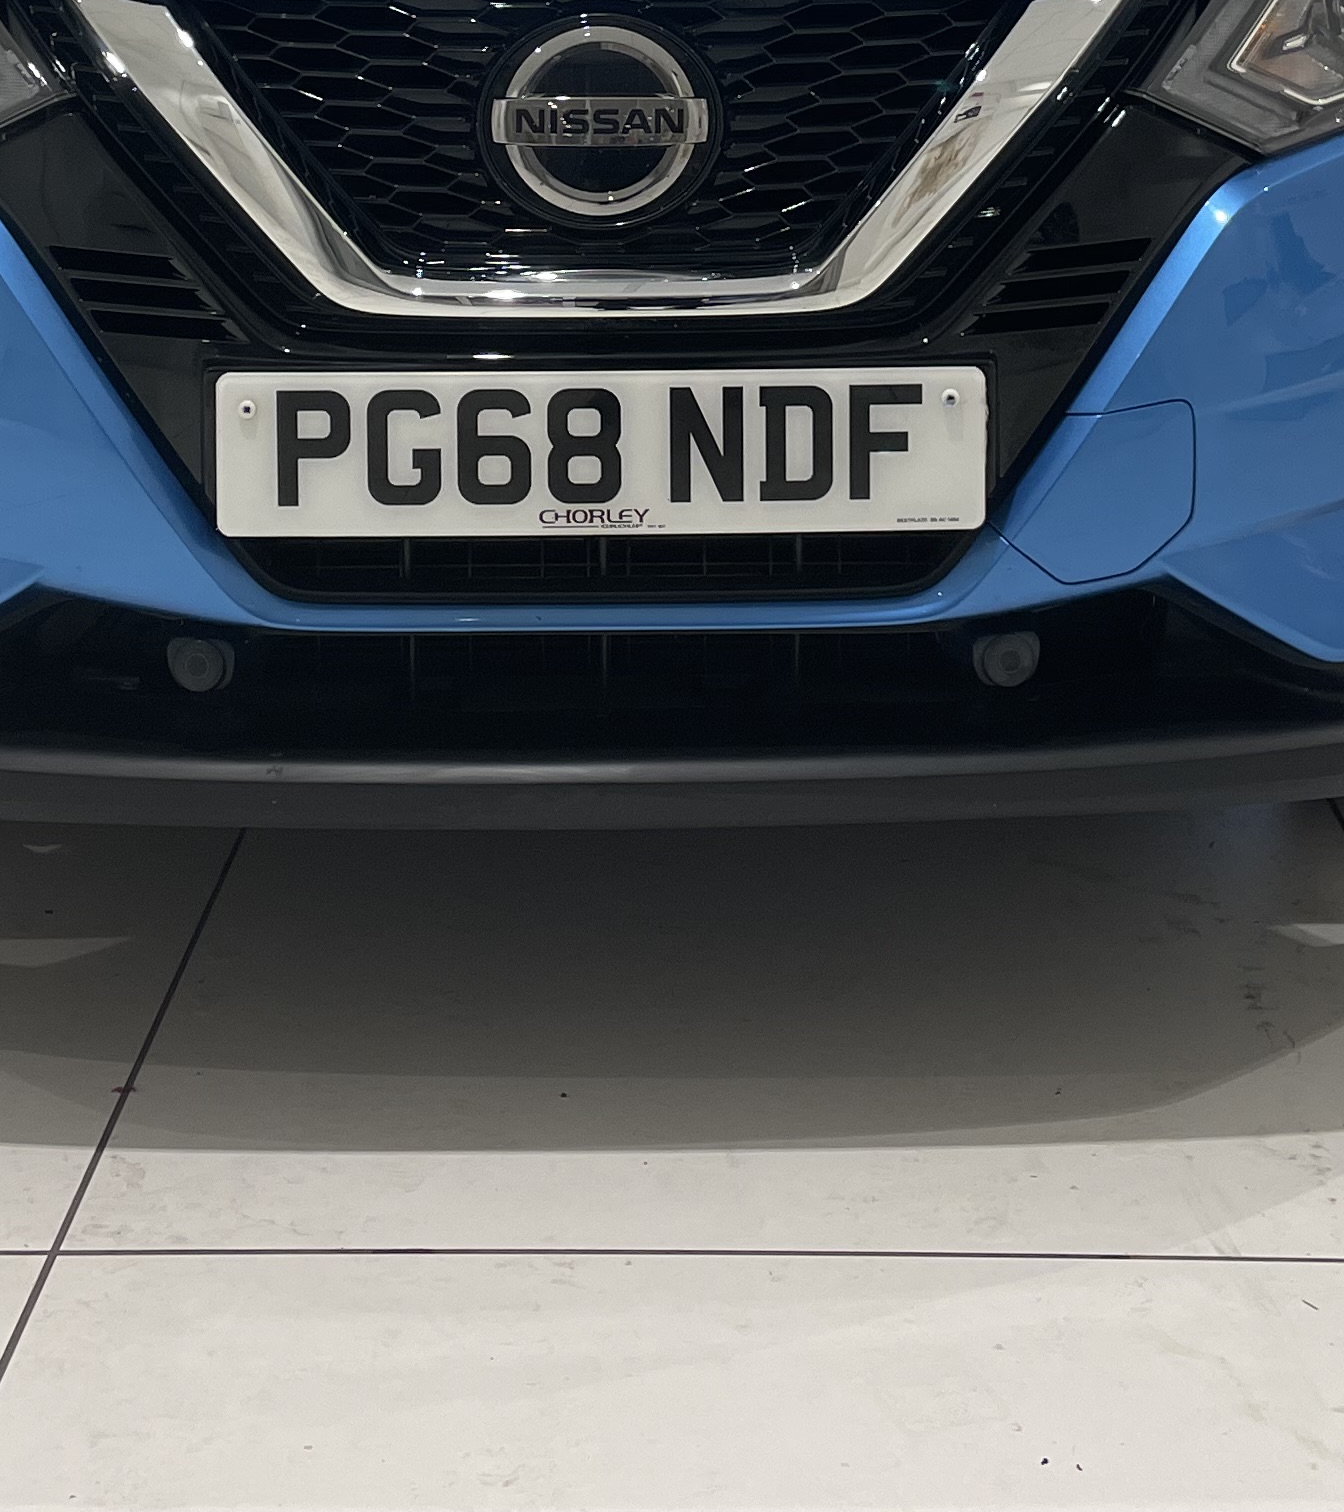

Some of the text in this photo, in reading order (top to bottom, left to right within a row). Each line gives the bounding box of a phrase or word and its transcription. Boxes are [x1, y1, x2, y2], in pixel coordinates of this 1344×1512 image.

[515, 108, 684, 135] NISSAN
[276, 384, 923, 506] PG68 NDF
[539, 508, 649, 524] CHORLEY
